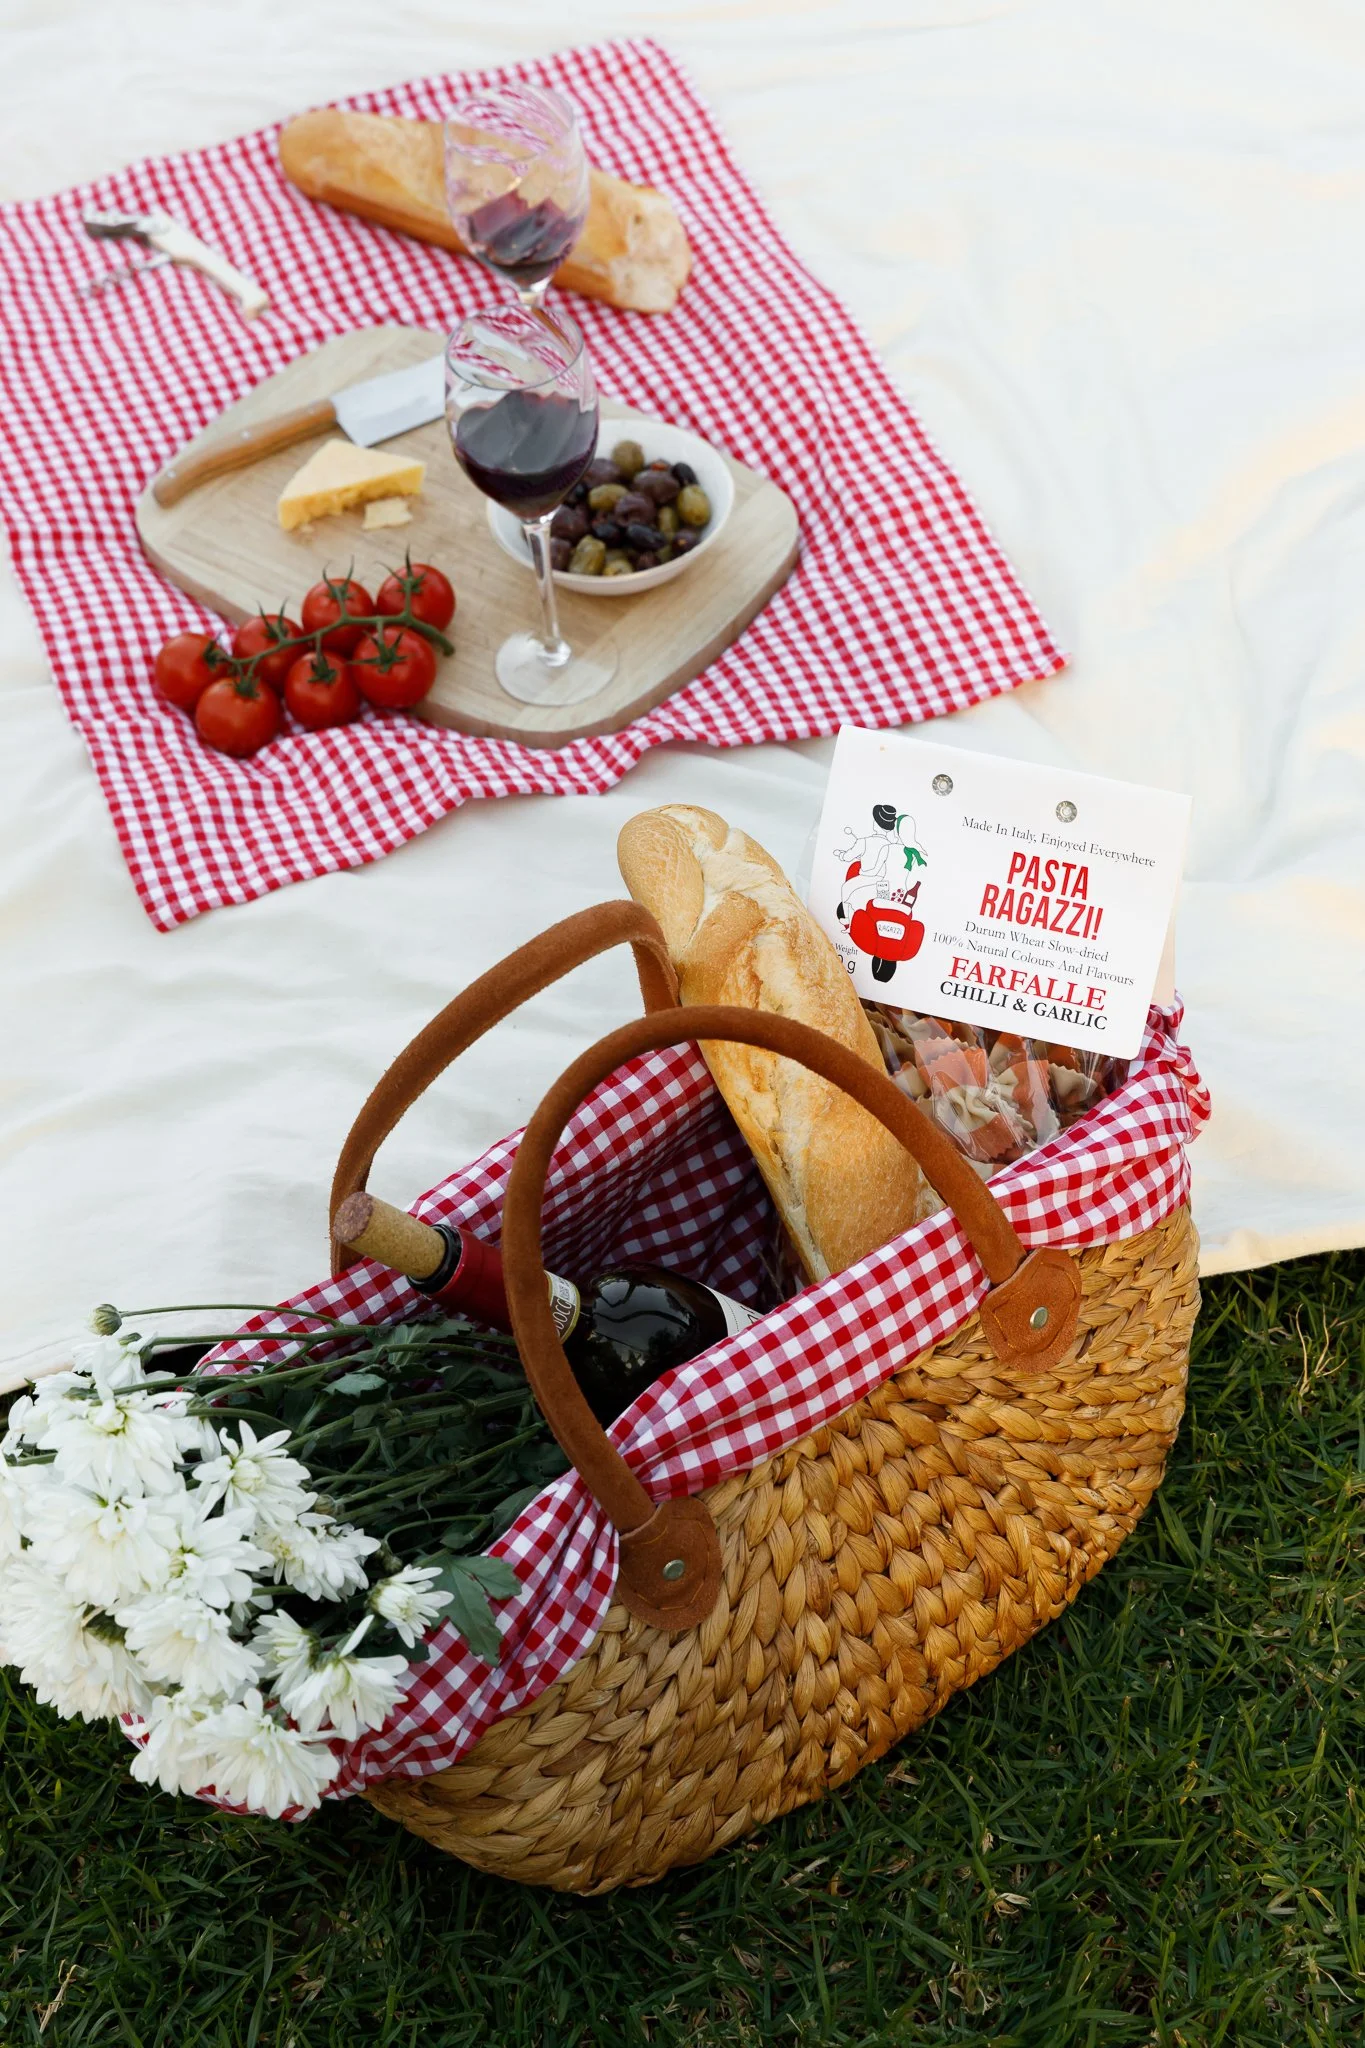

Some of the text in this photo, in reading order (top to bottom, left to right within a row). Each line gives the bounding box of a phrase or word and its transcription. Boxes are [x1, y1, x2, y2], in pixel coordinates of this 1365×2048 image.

[962, 816, 1156, 868] Made In Italy, Enjoyed Everywhere
[1007, 851, 1089, 901] PASTA
[979, 883, 1103, 941] RAGAZZI!
[932, 931, 1135, 986] 100% Natural Colours And Flavours
[964, 921, 1109, 963] Durum Wheat Slow-dried
[939, 980, 1109, 1031] CHILLI & GARLIC
[948, 956, 1107, 1011] FARFALLE
